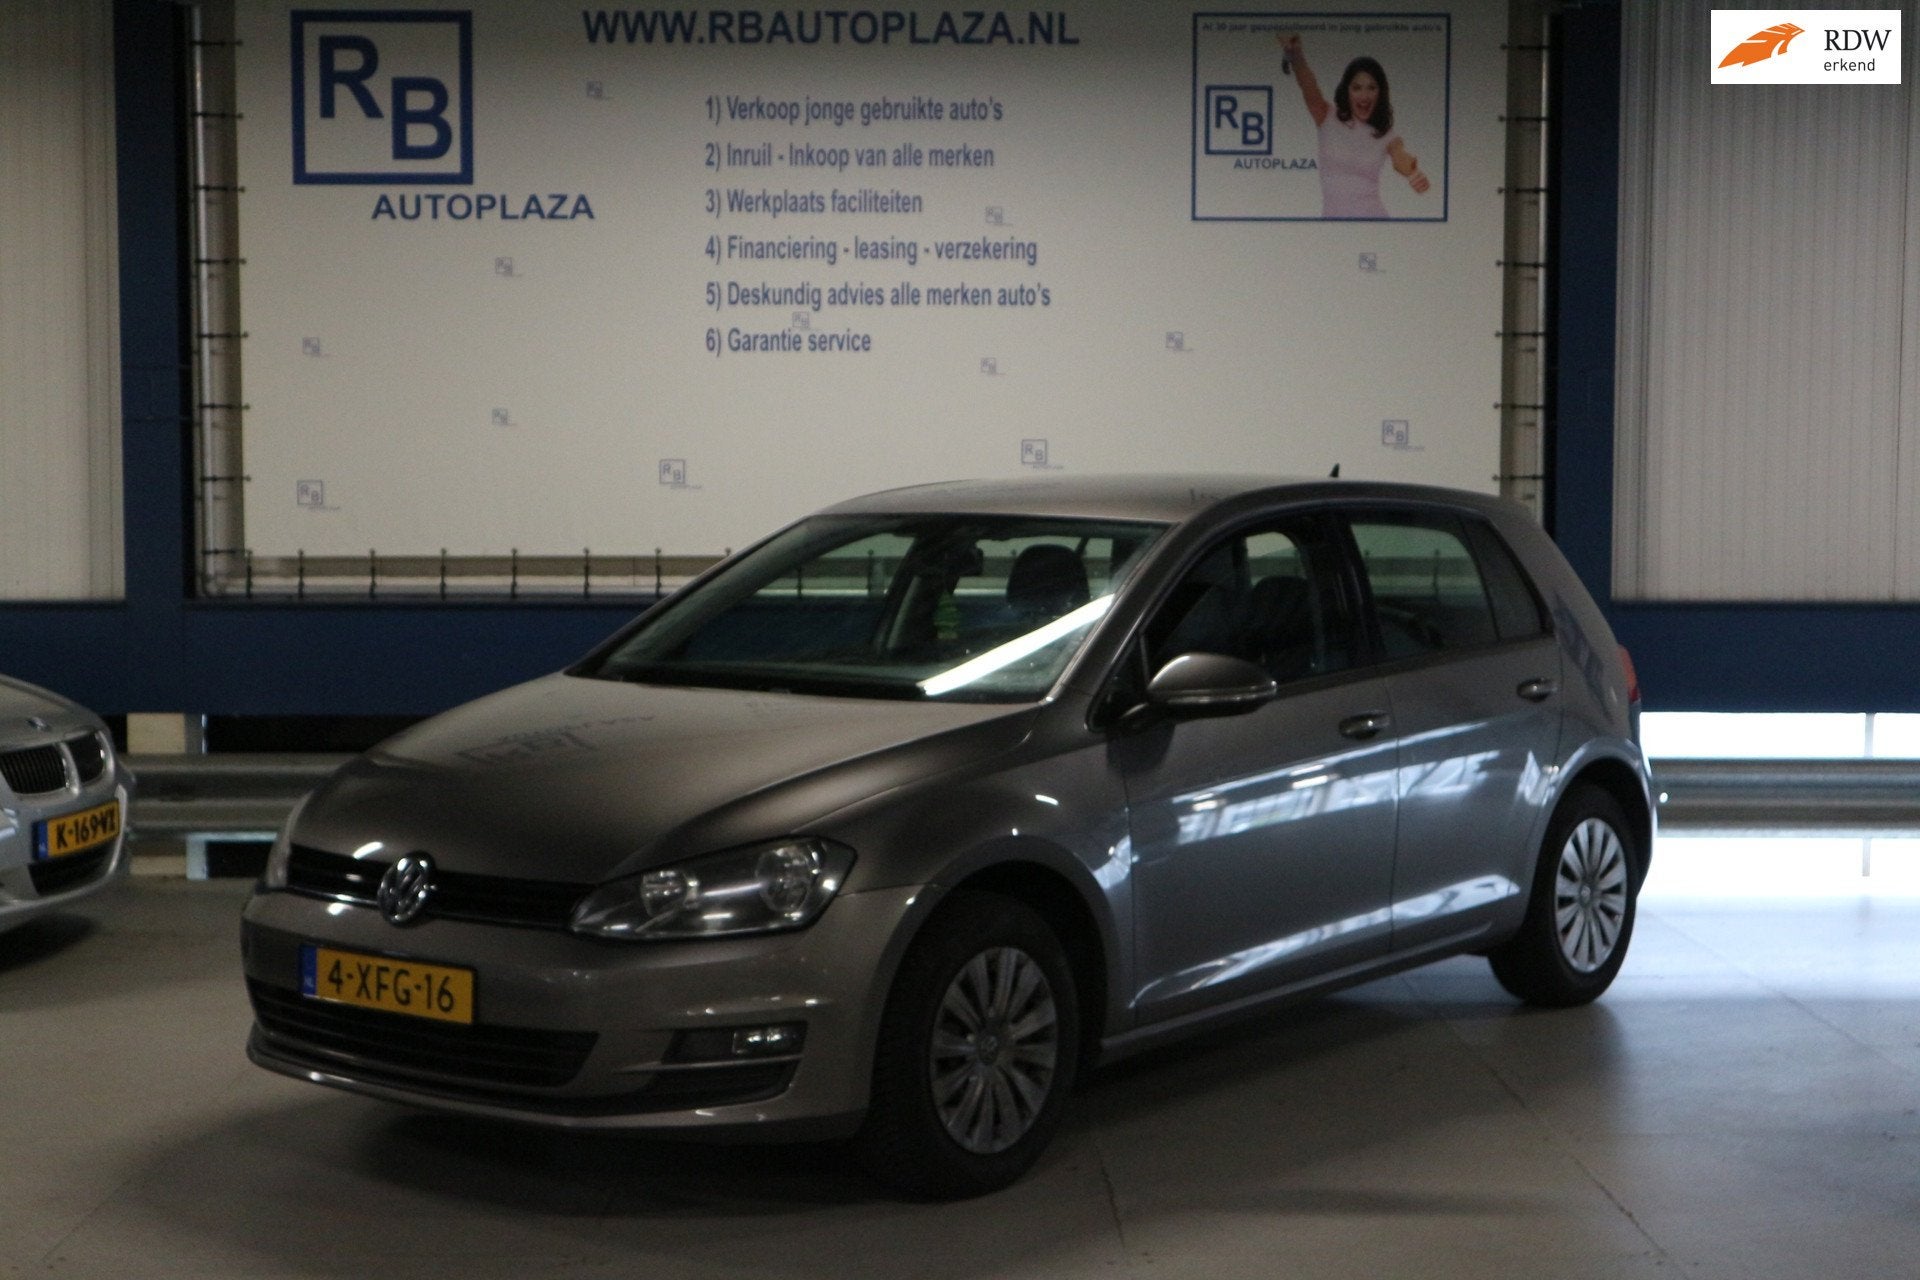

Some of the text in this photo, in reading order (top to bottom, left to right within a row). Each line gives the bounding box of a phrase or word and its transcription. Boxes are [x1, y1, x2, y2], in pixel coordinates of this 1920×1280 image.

[582, 10, 1079, 44] WWW.RBAUTOPLAZA.NL
[706, 95, 1003, 126] 1) Verkoop jonge gebruikte auto's
[706, 143, 721, 170] 2)
[727, 142, 771, 166] Inruil
[789, 143, 849, 171] Inkoop
[856, 149, 886, 166] van
[893, 143, 923, 166] alle
[929, 144, 994, 166] merken
[1235, 158, 1317, 169] AUTOPLAZA
[372, 194, 593, 220] AUTOPLAZA
[706, 189, 922, 218] 3) Werkplaats faciliteiten
[705, 236, 721, 264] 4)
[728, 235, 837, 265] Financiering
[855, 236, 917, 266] leasing
[935, 237, 1037, 266] verzekering
[707, 282, 1050, 312] 5) Deskundig advies alle merken auto's
[706, 327, 871, 356] 6) Garantie service
[327, 958, 455, 1014] 4-XFG-16
